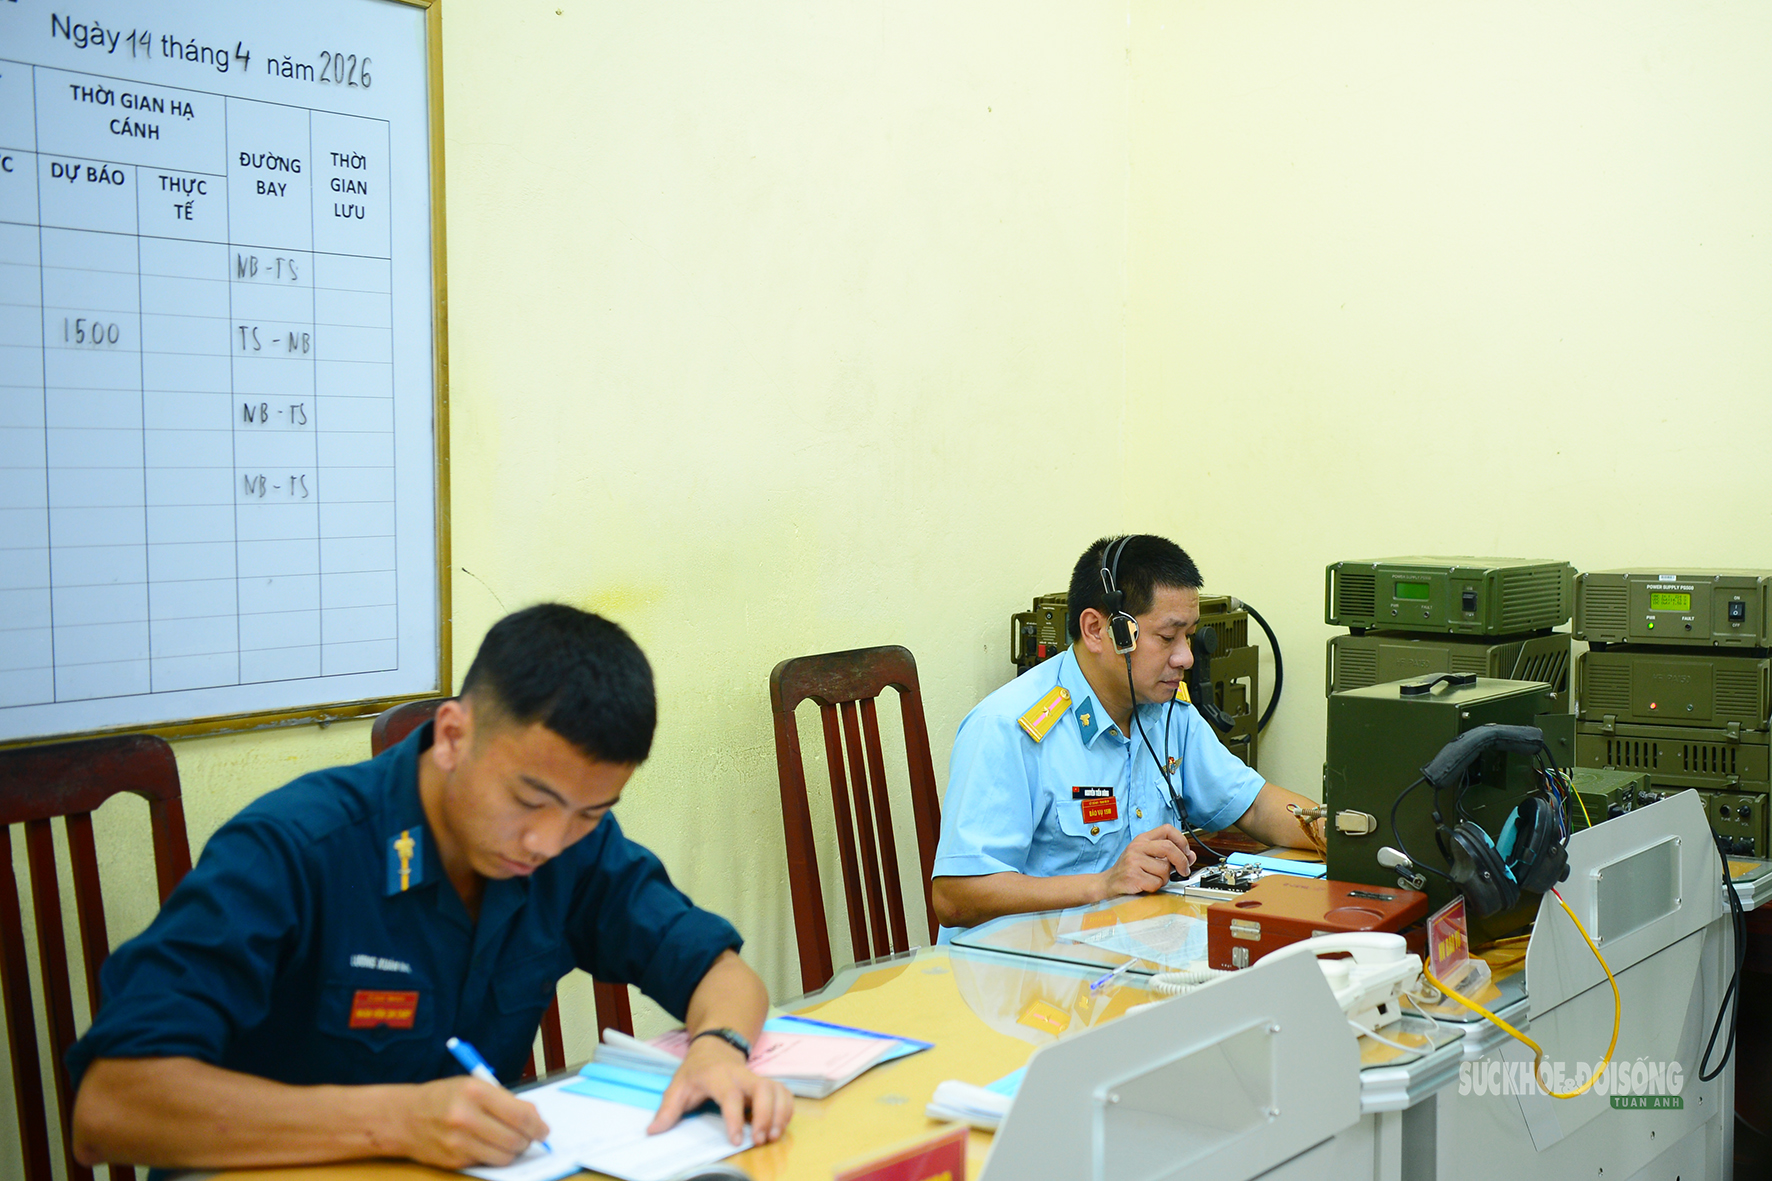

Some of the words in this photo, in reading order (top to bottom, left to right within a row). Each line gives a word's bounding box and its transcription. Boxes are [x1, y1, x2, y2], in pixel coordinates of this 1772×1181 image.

[51, 12, 121, 54] Ngày
[126, 28, 152, 59] 14
[161, 34, 230, 73] tháng
[234, 41, 251, 72] 4
[267, 54, 315, 82] năm
[319, 50, 373, 89] 2026
[69, 84, 115, 107] THỜI
[120, 92, 164, 114] GIAN
[170, 100, 195, 121] HẠ
[109, 116, 160, 140] CÁNH
[0, 154, 14, 173] C
[239, 151, 302, 174] ĐƯỜNG
[330, 151, 367, 171] THỜI
[51, 162, 81, 184] DỰ
[86, 164, 126, 186] BÁO
[158, 175, 208, 197] THỰC
[256, 180, 287, 198] BAY
[330, 178, 368, 196] GIAN
[173, 200, 195, 221] TẾ
[334, 203, 366, 220] LƯU
[238, 325, 262, 351] TS
[288, 331, 311, 354] NB
[243, 402, 269, 424] NB
[290, 402, 308, 426] TS
